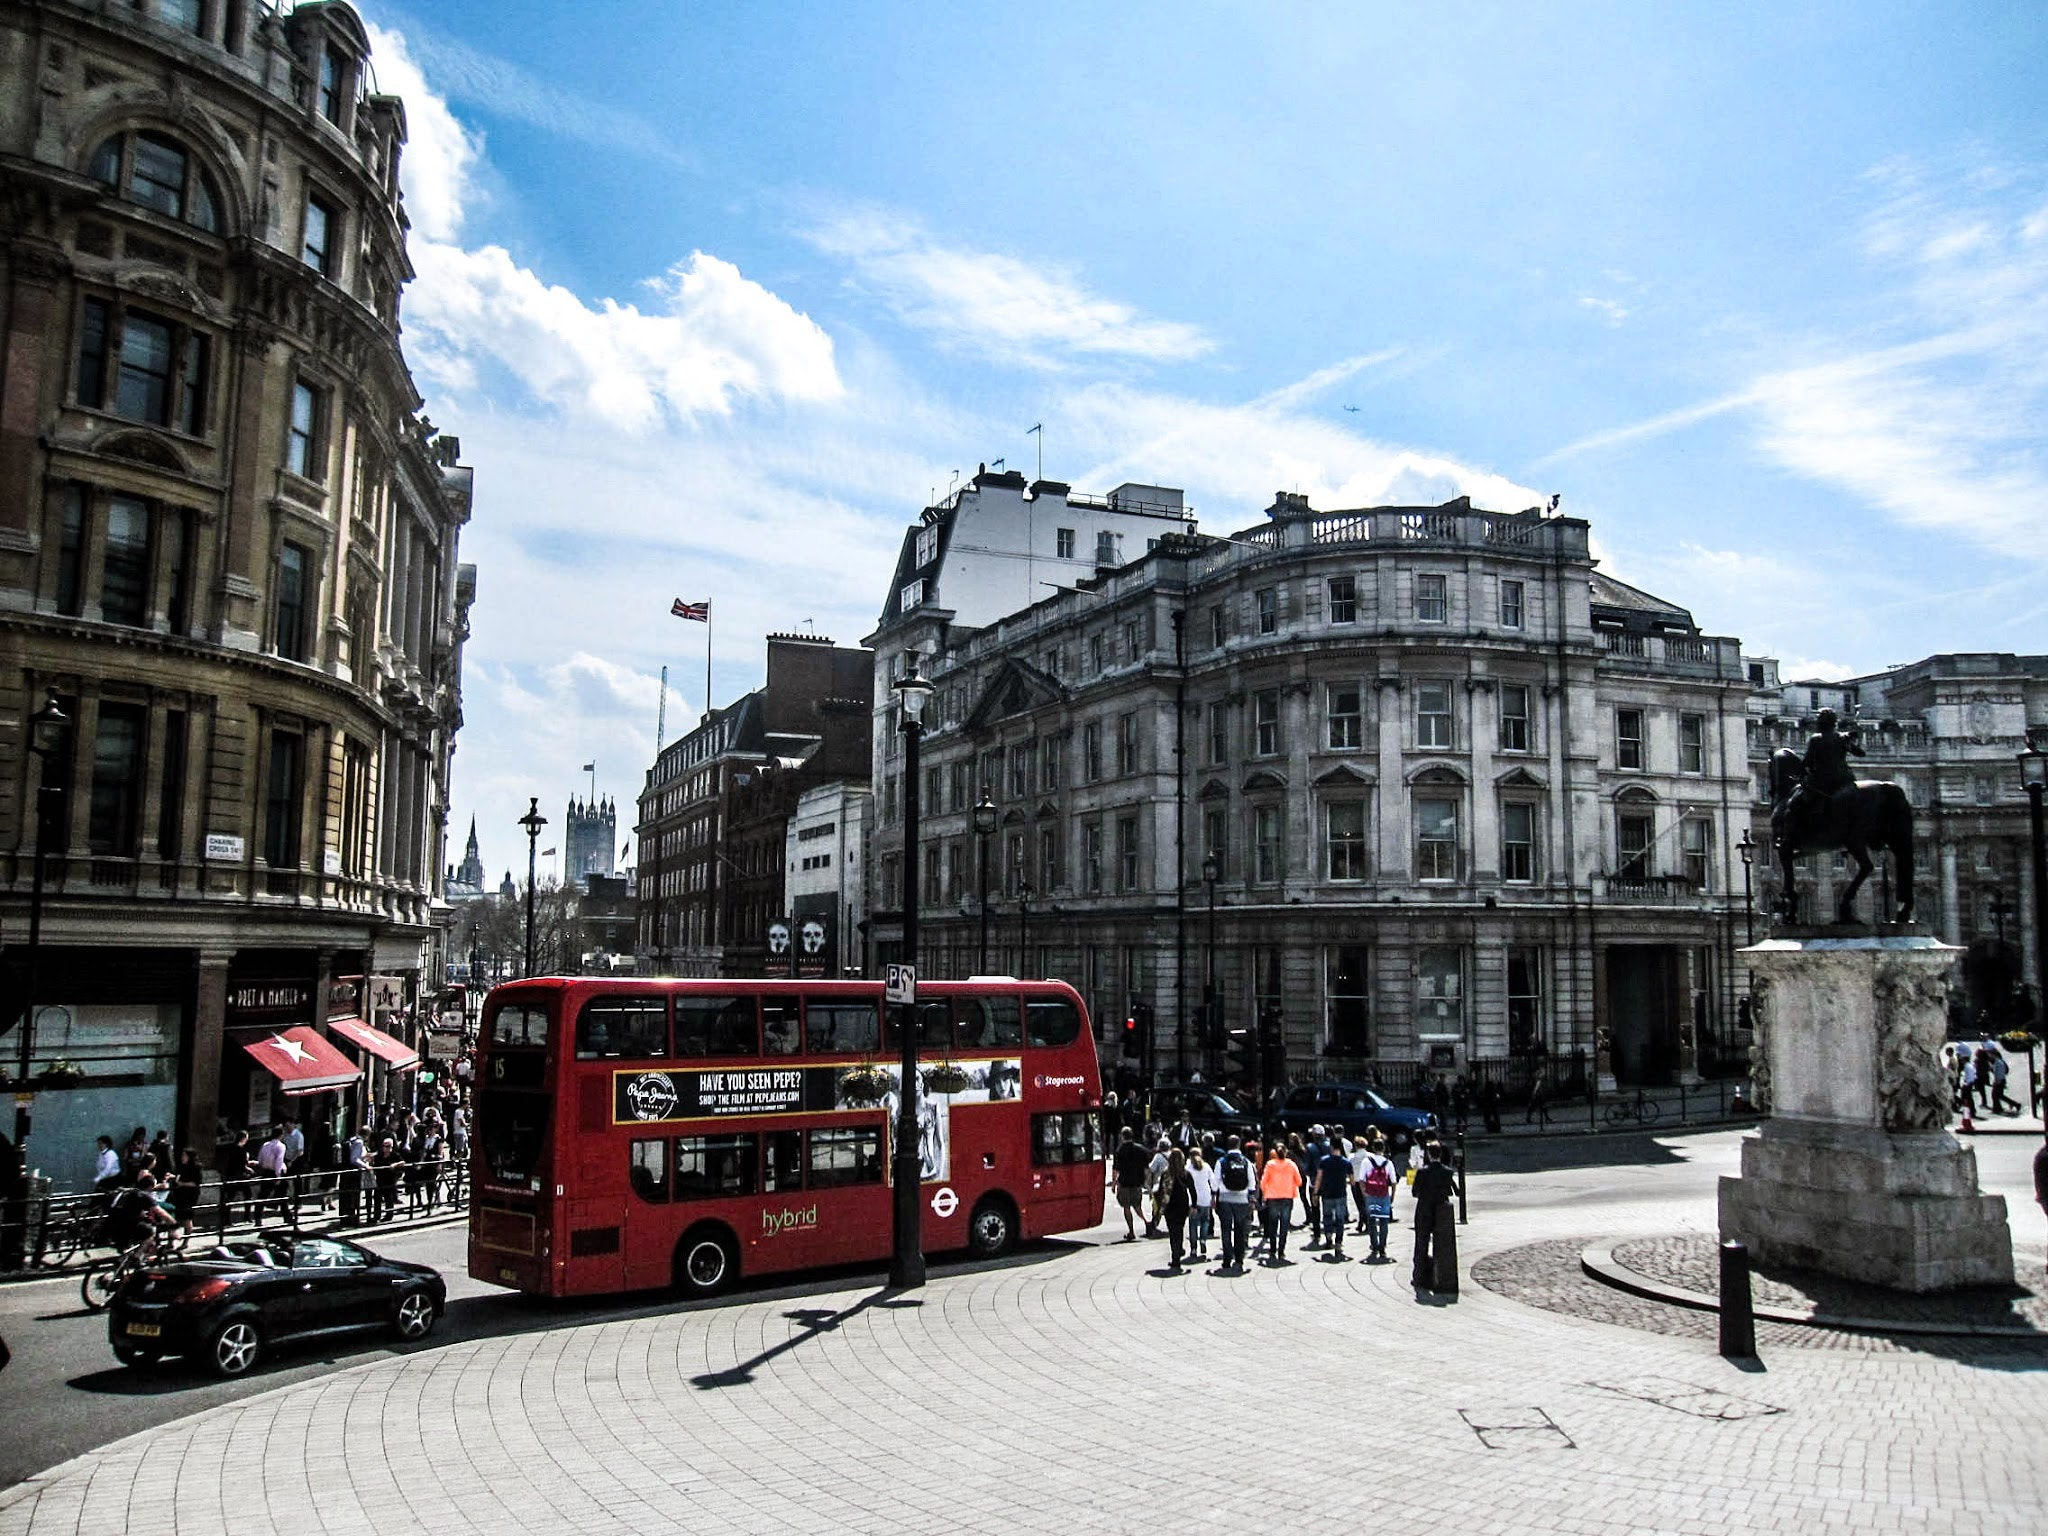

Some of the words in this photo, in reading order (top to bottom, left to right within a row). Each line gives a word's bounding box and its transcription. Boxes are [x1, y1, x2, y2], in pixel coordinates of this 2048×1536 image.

[890, 968, 898, 986] P
[237, 988, 256, 1007] PRET
[259, 989, 265, 1006] A
[267, 987, 298, 1006] MANGER
[495, 1057, 505, 1079] 15
[700, 1074, 724, 1092] HAVE
[726, 1072, 746, 1091] YOU
[747, 1072, 771, 1090] SEEN
[774, 1071, 802, 1089] PEPE?
[1045, 1075, 1085, 1088] Stagecoach
[626, 1082, 649, 1106] Pepe
[648, 1086, 679, 1104] Jeans
[699, 1094, 716, 1106] SHOP
[718, 1094, 730, 1105] THE
[731, 1093, 745, 1105] FILM
[746, 1092, 753, 1104] AT
[754, 1091, 800, 1104] PEPEJEANS.COM
[762, 1203, 816, 1237] hybrid
